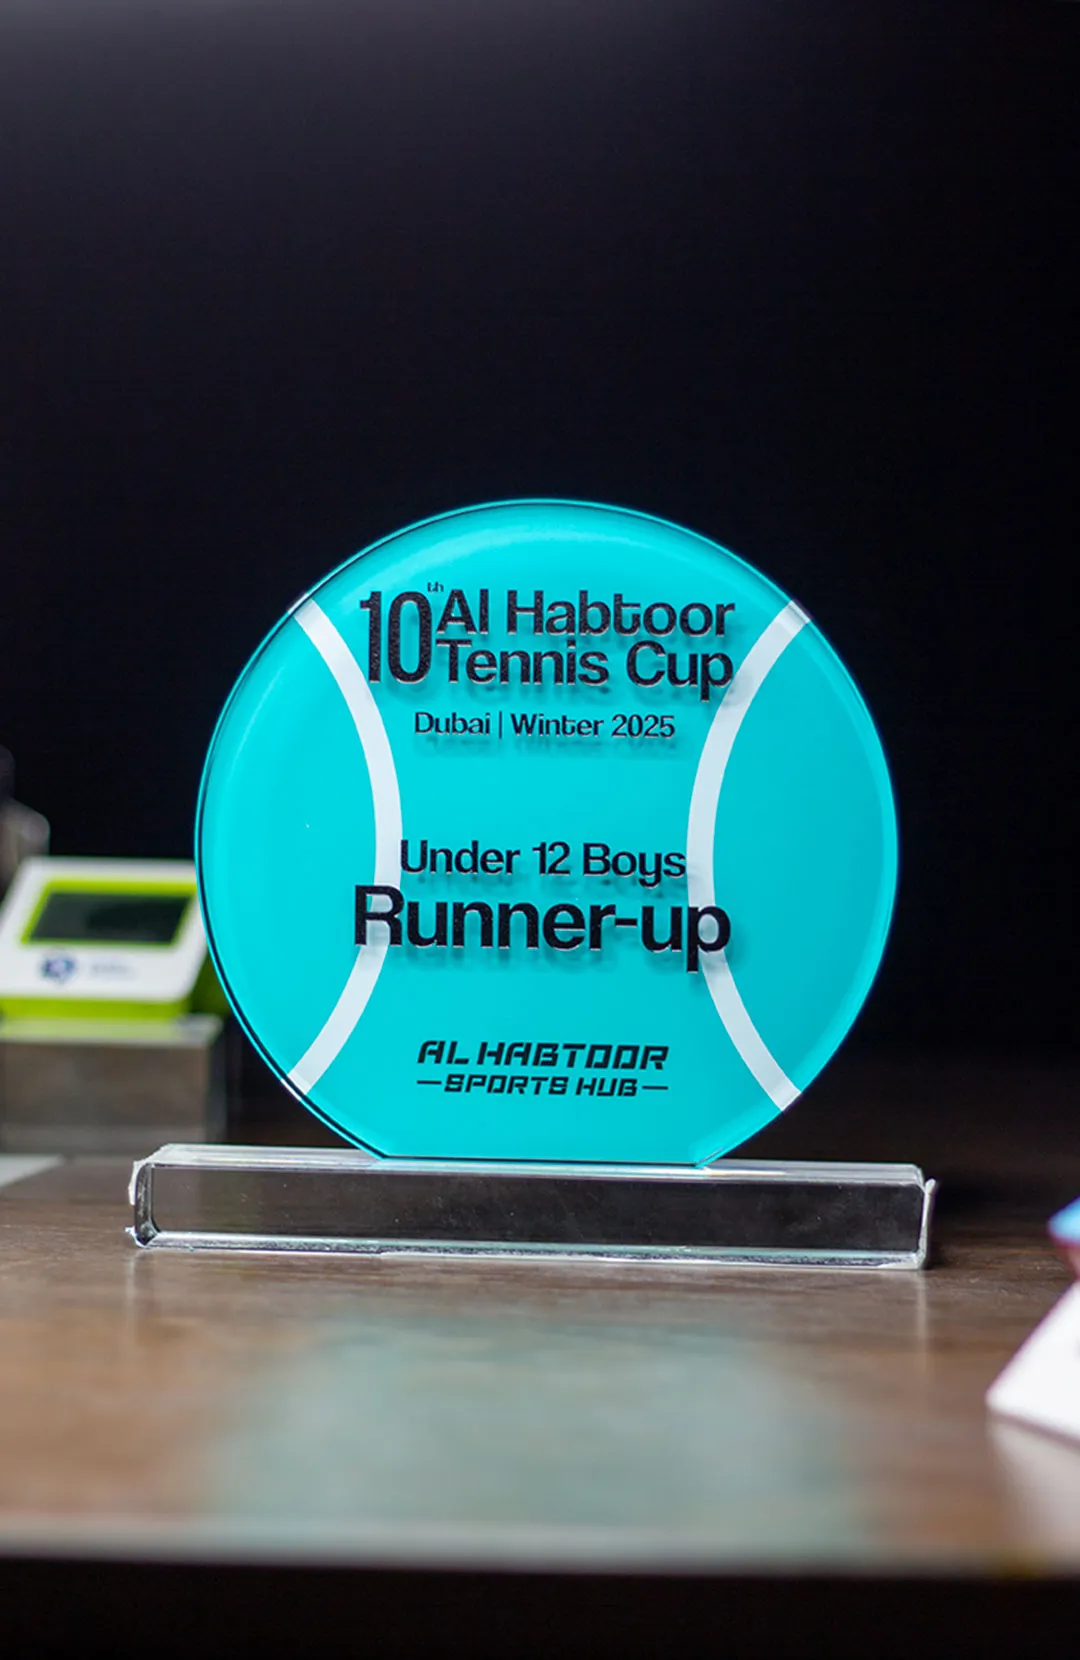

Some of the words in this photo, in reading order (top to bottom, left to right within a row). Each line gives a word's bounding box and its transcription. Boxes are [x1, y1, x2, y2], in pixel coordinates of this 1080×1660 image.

[436, 588, 489, 635] Al
[506, 590, 736, 637] Habtoor
[436, 639, 610, 687] Tennis
[626, 641, 734, 703] Cup
[415, 712, 491, 735] Dubai
[510, 713, 604, 738] Winter
[611, 714, 676, 739] 2025
[400, 839, 521, 875] Under
[532, 841, 570, 876] 12
[583, 843, 687, 888] Boys
[354, 884, 731, 974] Runner-up
[417, 1040, 469, 1065] AL
[476, 1042, 669, 1070] HABTOOR
[444, 1074, 568, 1095] SPORTS
[575, 1076, 638, 1097] HUB
